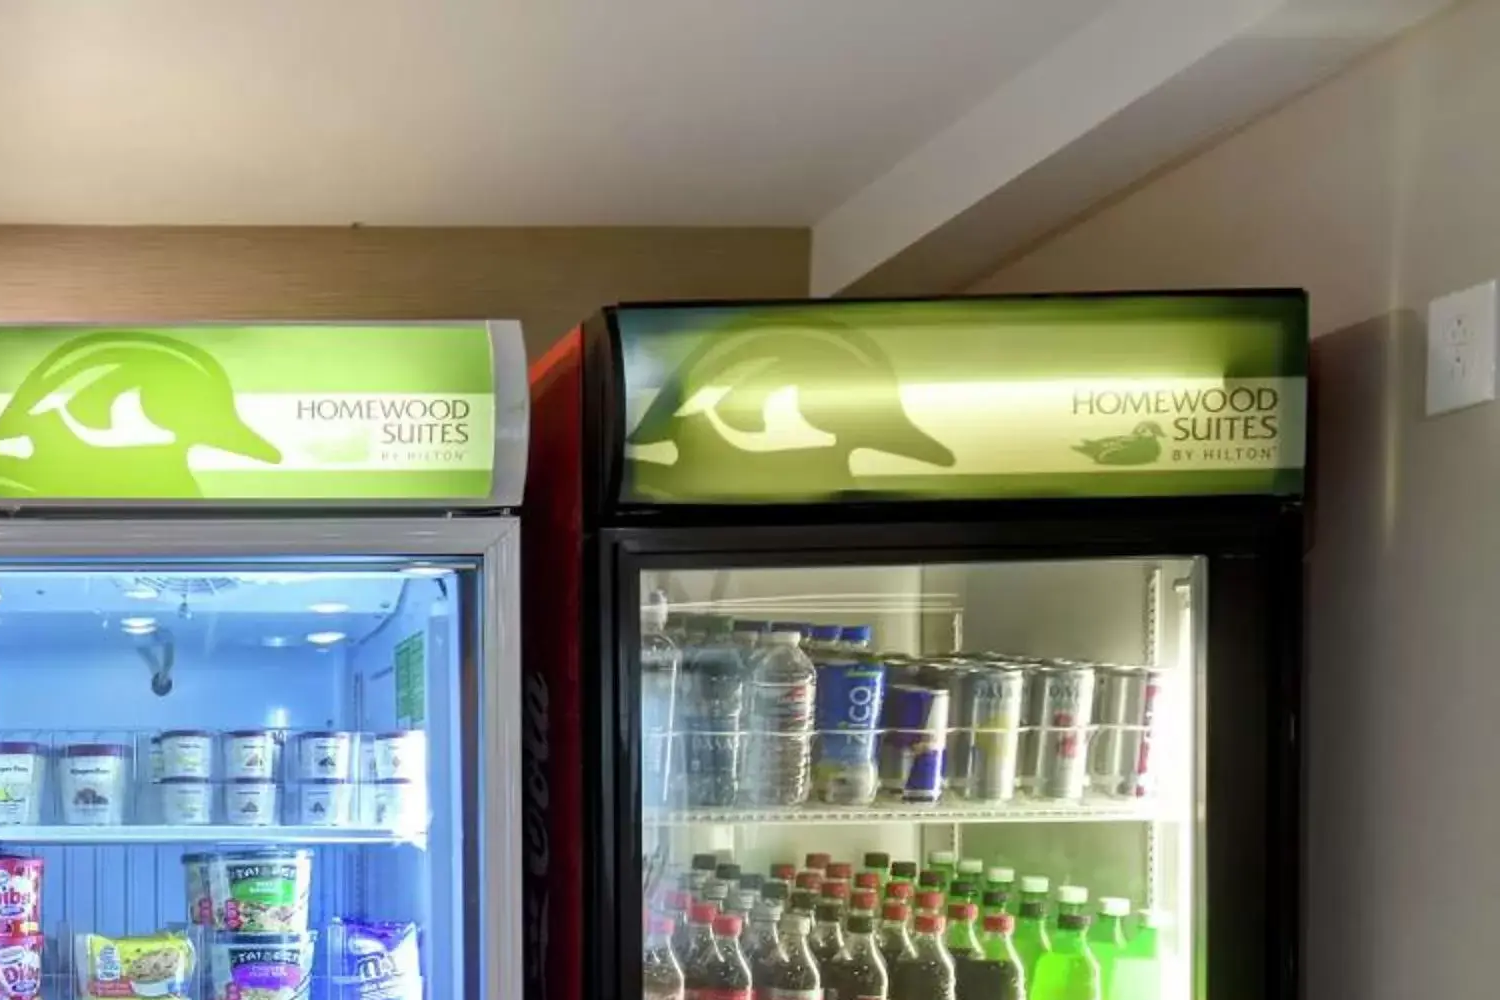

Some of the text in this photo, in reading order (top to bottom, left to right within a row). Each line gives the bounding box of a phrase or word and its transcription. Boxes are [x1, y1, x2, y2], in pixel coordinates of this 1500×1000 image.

[297, 399, 470, 420] HOMEWOOD
[1071, 387, 1278, 415] HOMEWOOD
[381, 423, 469, 444] SUITES
[1172, 416, 1278, 441] SUITES
[381, 450, 463, 461] BY HILTON
[1173, 446, 1273, 461] BY HILTON
